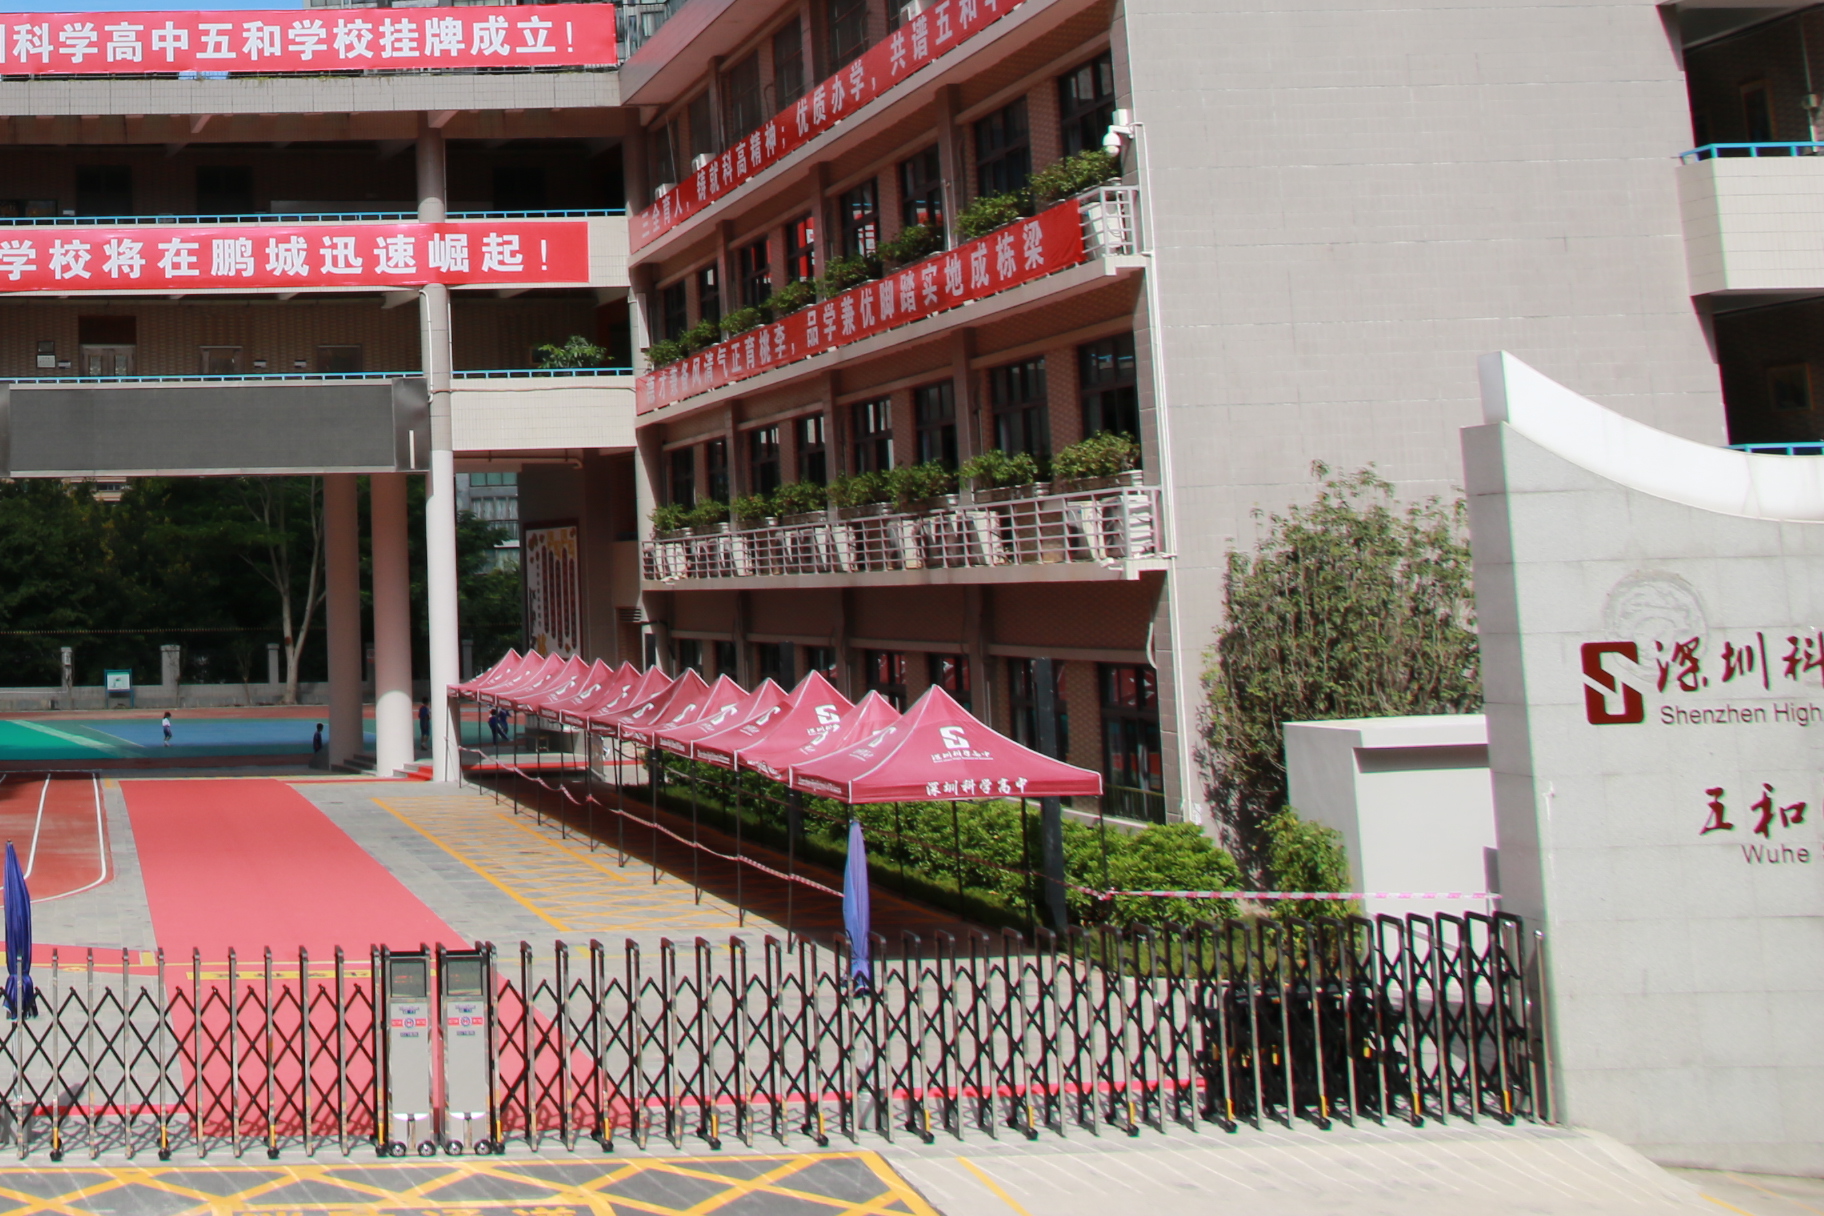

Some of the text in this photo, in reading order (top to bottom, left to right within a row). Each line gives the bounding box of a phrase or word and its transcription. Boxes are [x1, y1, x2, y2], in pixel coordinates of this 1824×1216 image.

[1660, 703, 1823, 727] Shenzhen High
[926, 777, 1028, 797] 深圳科学高中
[1742, 845, 1810, 865] Wuhe
